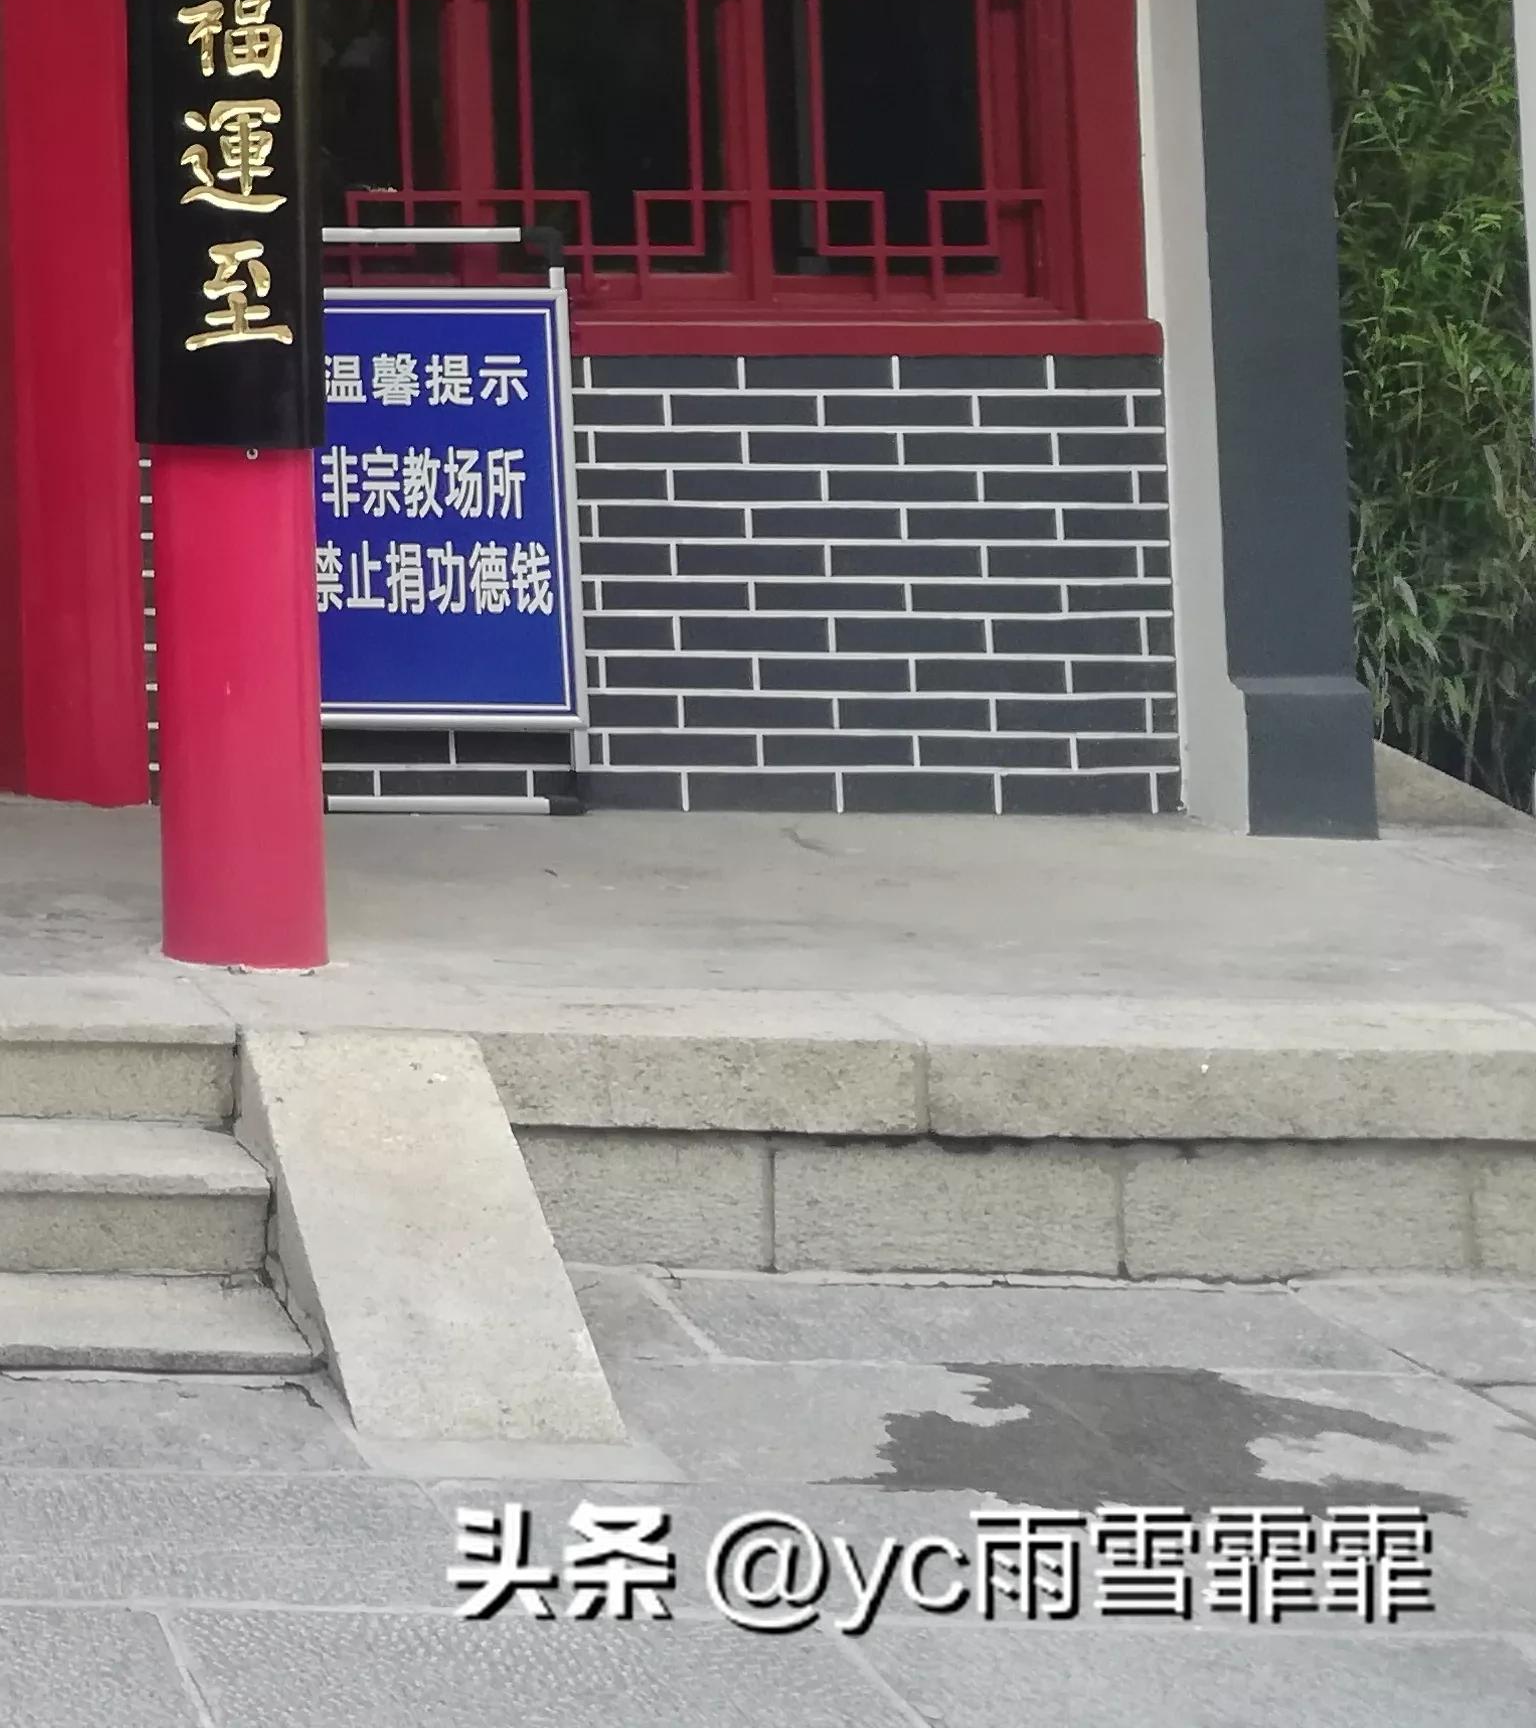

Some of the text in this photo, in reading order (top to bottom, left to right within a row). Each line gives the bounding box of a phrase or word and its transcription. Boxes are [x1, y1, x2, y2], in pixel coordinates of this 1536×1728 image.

[323, 352, 530, 407] 温馨提示
[320, 444, 528, 520] 非宗教场所
